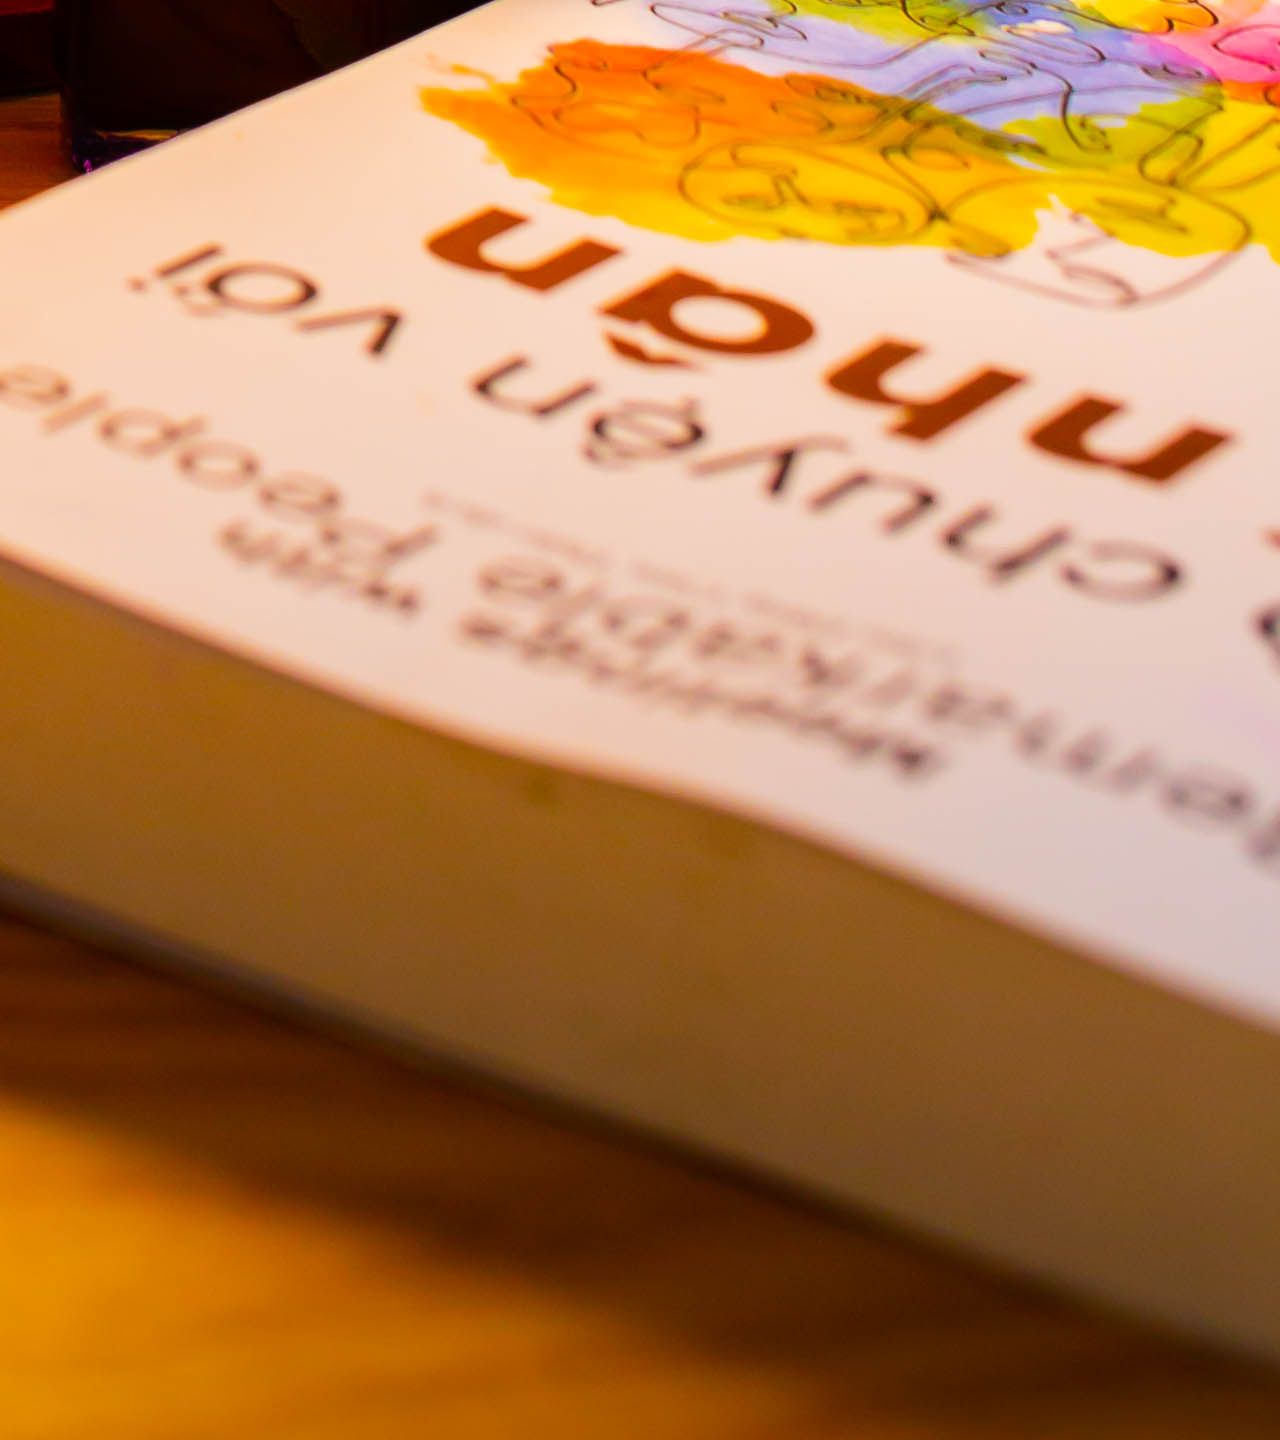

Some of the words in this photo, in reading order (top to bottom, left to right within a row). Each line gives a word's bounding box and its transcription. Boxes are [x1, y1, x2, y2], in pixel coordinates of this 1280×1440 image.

[129, 242, 404, 359] với
[425, 205, 1236, 483] nhân
[469, 353, 1183, 602] chuyện
